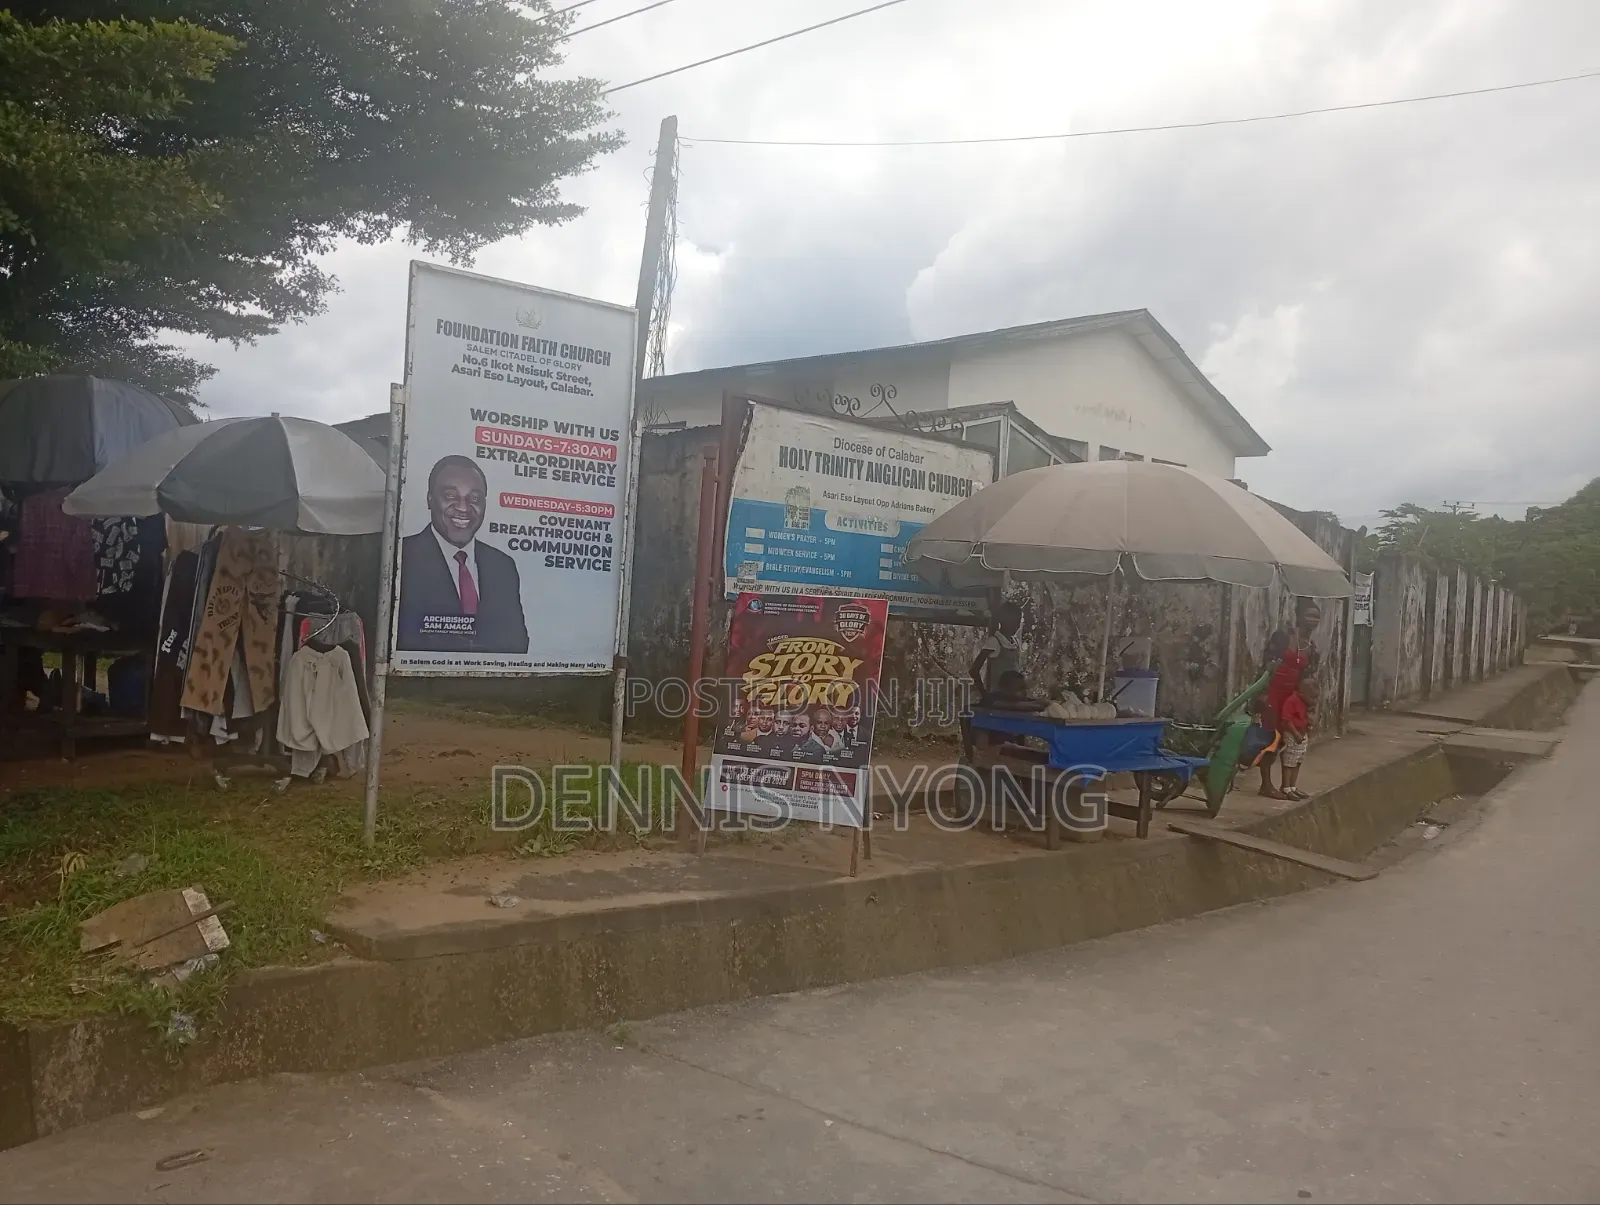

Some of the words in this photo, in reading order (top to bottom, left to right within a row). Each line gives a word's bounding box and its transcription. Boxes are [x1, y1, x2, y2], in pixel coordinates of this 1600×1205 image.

[436, 318, 519, 350] FOUNDATION
[521, 335, 558, 357] FAITH
[560, 343, 611, 367] CHURCH
[466, 343, 498, 356] SALEM
[500, 350, 538, 364] CITADEL
[539, 357, 552, 366] OF
[553, 360, 582, 371] GLORY
[451, 364, 482, 377] Asari
[484, 369, 504, 381] Eso
[506, 373, 548, 391] Layout,
[550, 381, 594, 397] Calabar.
[462, 353, 488, 367] No.6
[490, 359, 514, 372] Ikot
[516, 363, 554, 379] Nsisuk
[556, 371, 592, 387] Street,
[470, 408, 549, 431] WORSHIP
[553, 421, 595, 438] WITH
[600, 427, 619, 441] US
[481, 430, 612, 459] SUNDAYS-7:30AM
[833, 437, 873, 455] Diocese
[875, 445, 886, 458] of
[888, 449, 924, 465] Calabar
[476, 446, 617, 476] EXTRA-ORDINARY
[779, 445, 813, 473] HOLY
[814, 452, 865, 480] TRINITY
[865, 461, 926, 490] ANGLICAN
[927, 471, 973, 498] CHURCH
[514, 464, 548, 480] LIFE
[552, 469, 616, 488] SERVICE
[503, 495, 613, 516] WEDNESDAY-5:30PM
[822, 489, 840, 500] Asari
[853, 496, 875, 506] Layout
[876, 499, 890, 509] Opp
[890, 501, 914, 511] Adrians
[915, 504, 936, 515] Bakery
[489, 522, 601, 542] BREAKTHROUGH
[604, 533, 613, 544] &
[538, 514, 611, 532] COVENANT
[836, 515, 888, 533] ACTIVITIES
[508, 538, 612, 558] COMMUNION
[768, 530, 794, 541] WOMEN'S
[796, 534, 817, 544] PRAYER
[824, 537, 836, 546] 5PM
[544, 555, 612, 572] SERVICE
[767, 546, 794, 557] MIDWEEK
[794, 550, 817, 559] SERVICE
[823, 553, 836, 561] 5PM
[765, 562, 782, 571] BIBLE
[841, 570, 852, 578] 5PM
[764, 584, 779, 593] WITH
[781, 586, 791, 594] US
[791, 586, 799, 594] IN
[423, 615, 475, 624] ARCHBISHOP
[443, 623, 473, 631] AMAGA
[839, 621, 864, 629] GLORY
[774, 641, 835, 655] FROM
[743, 653, 864, 680] STORY
[792, 674, 812, 683] TO
[746, 682, 860, 708] GLORY
[801, 770, 814, 779] 5PM
